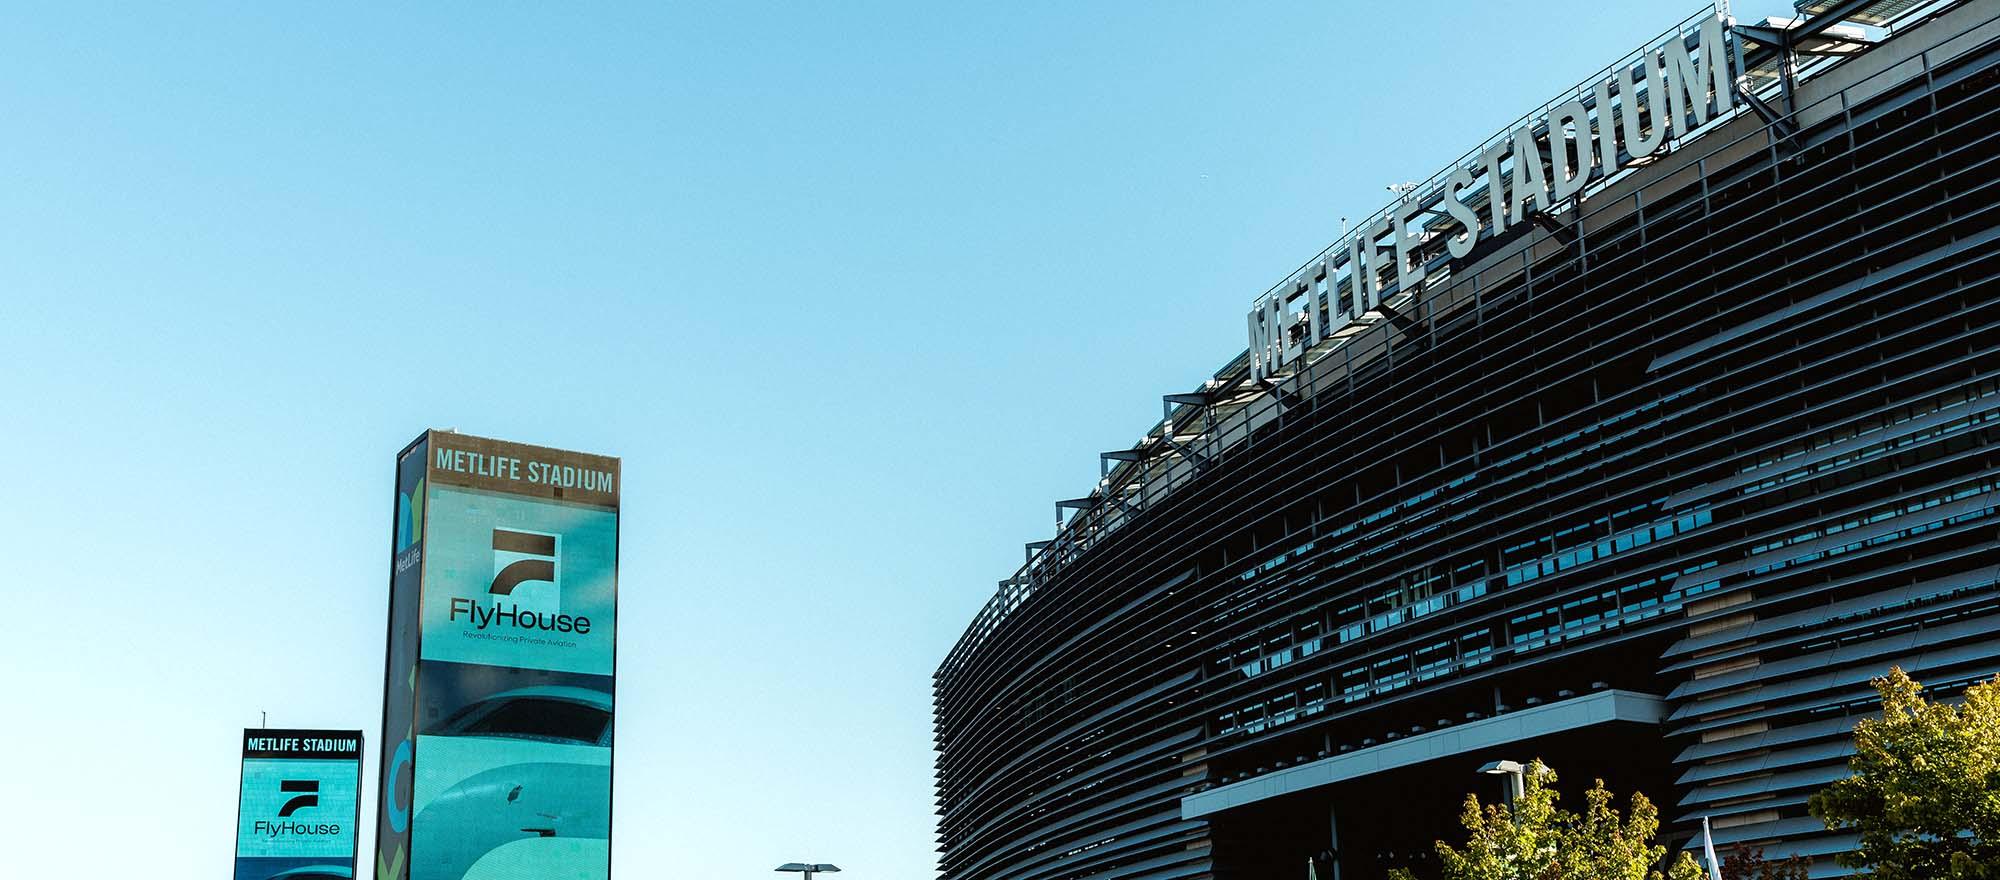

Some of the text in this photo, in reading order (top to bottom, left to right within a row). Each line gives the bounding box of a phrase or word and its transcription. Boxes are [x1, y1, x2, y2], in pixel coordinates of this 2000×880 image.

[1248, 13, 1735, 385] METLIFE STADIUM
[436, 447, 521, 481] METLIFE
[528, 461, 613, 494] STADIUM
[449, 597, 591, 634] FlyHouse
[463, 630, 518, 645] Revolutiozing
[248, 737, 357, 752] METLIFE STADIUM
[254, 821, 340, 838] FlyHouse
